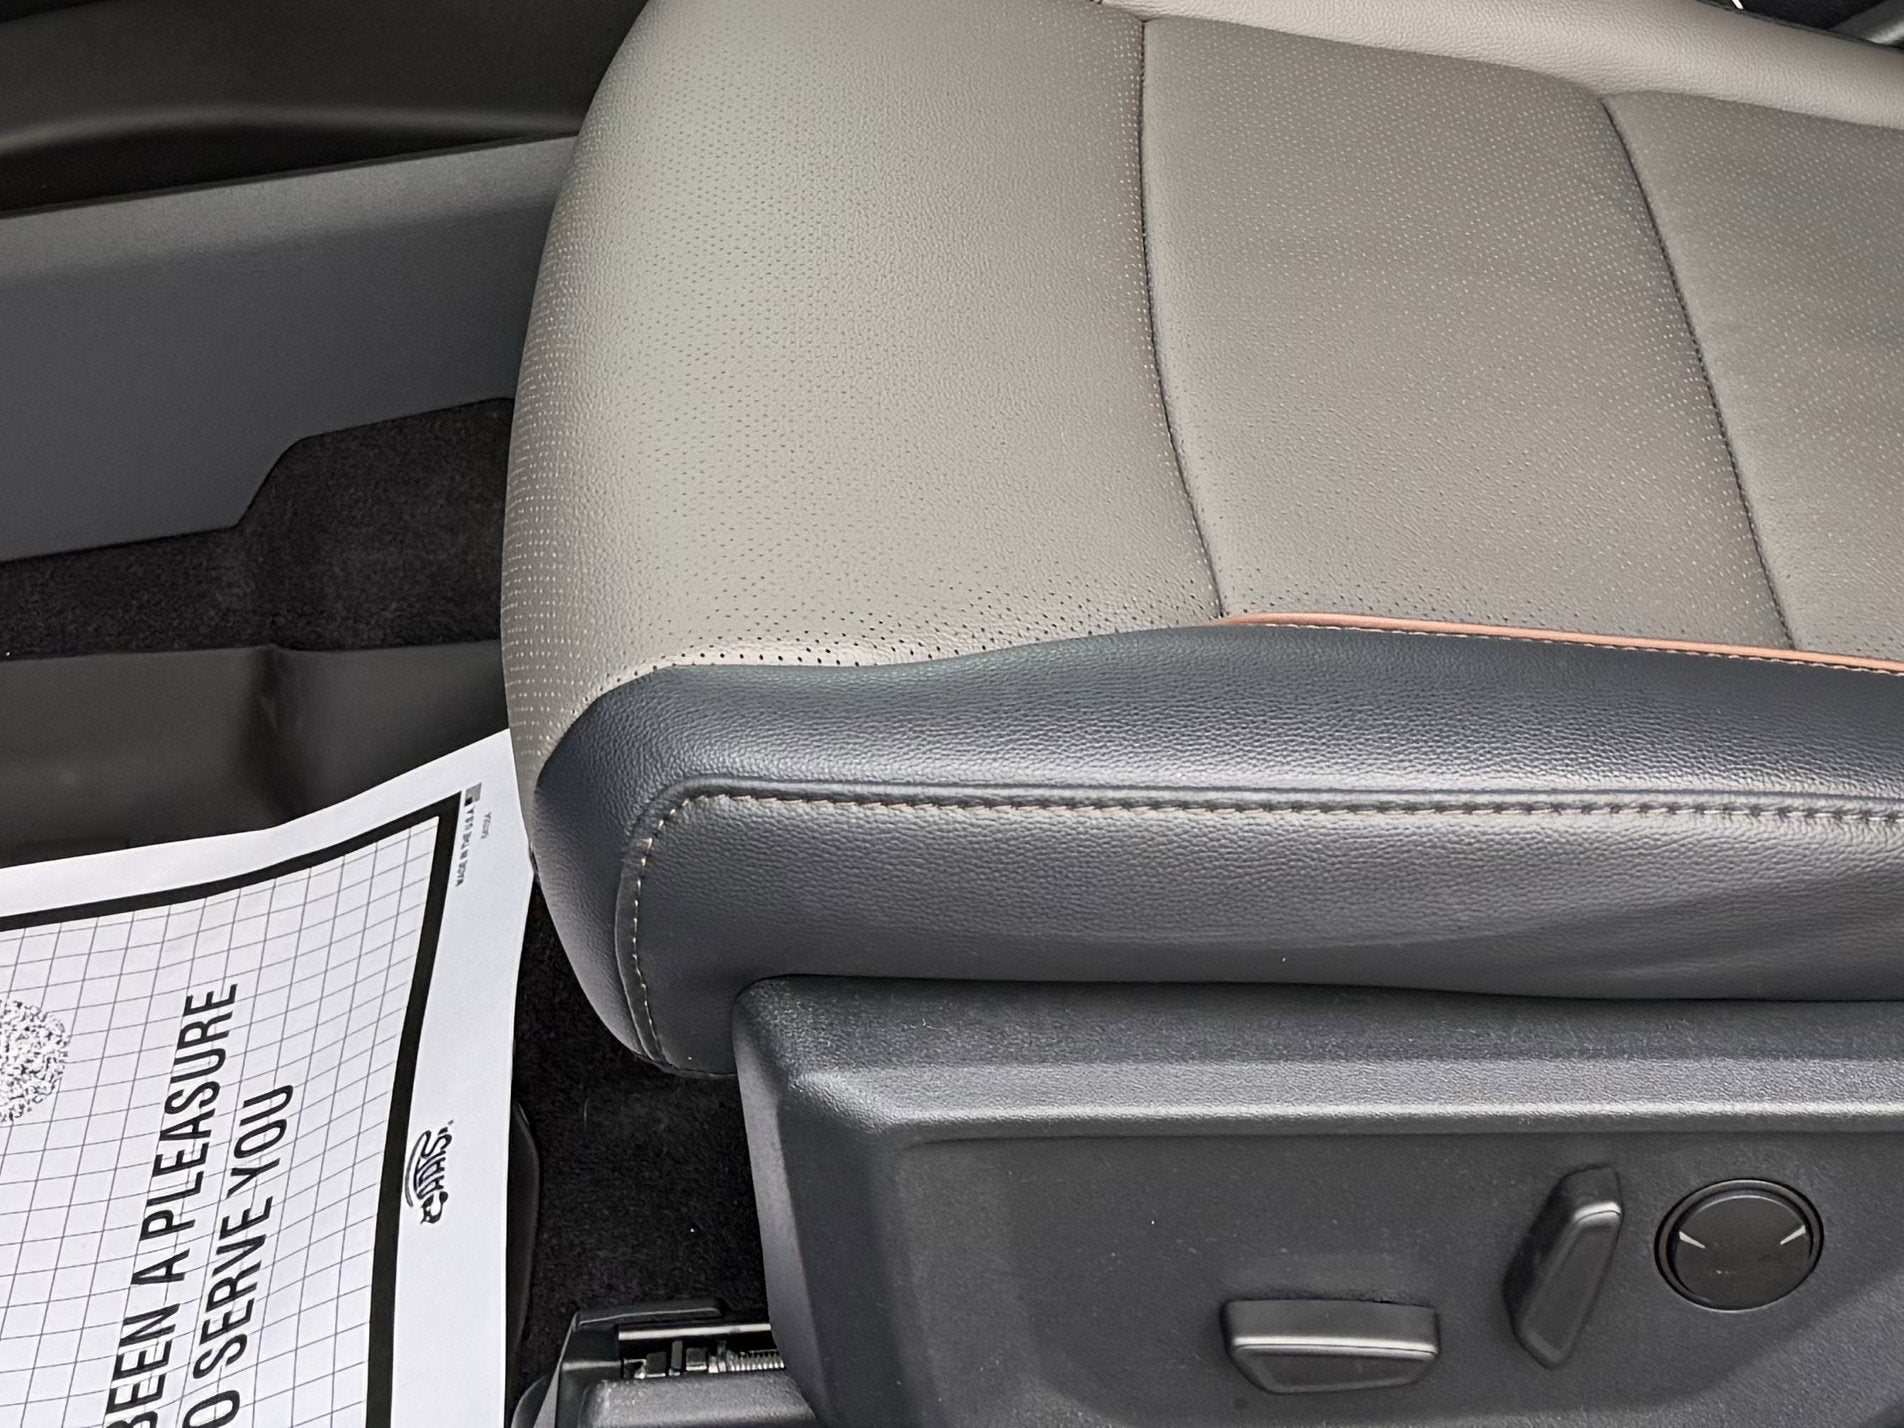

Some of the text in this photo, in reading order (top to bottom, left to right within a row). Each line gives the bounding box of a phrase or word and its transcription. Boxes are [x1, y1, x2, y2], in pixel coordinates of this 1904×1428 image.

[139, 984, 238, 1242] PLEASURE
[130, 1249, 191, 1285] A
[182, 1084, 294, 1428] O SERVE YOU
